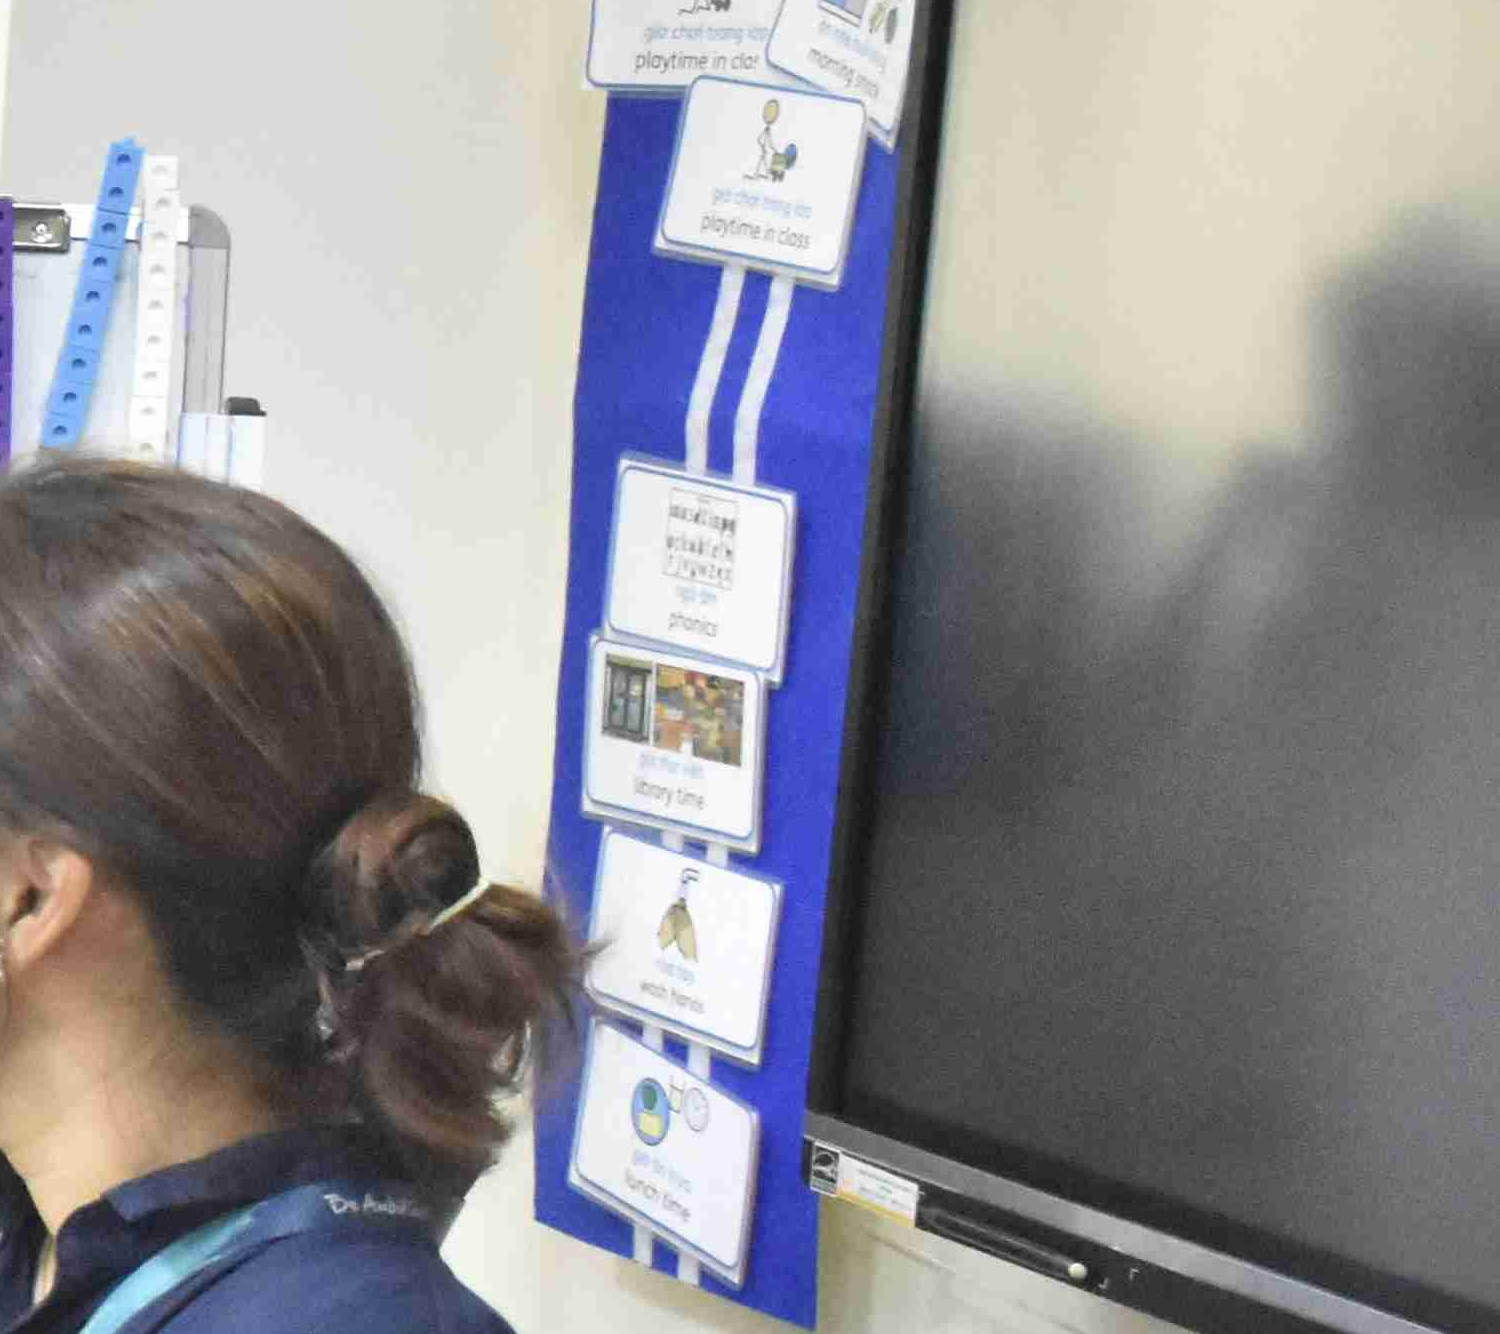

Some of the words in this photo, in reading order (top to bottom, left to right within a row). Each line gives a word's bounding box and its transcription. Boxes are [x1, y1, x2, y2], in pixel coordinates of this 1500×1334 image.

[634, 49, 708, 74] playtime
[712, 50, 727, 70] in
[699, 212, 761, 241] playtime
